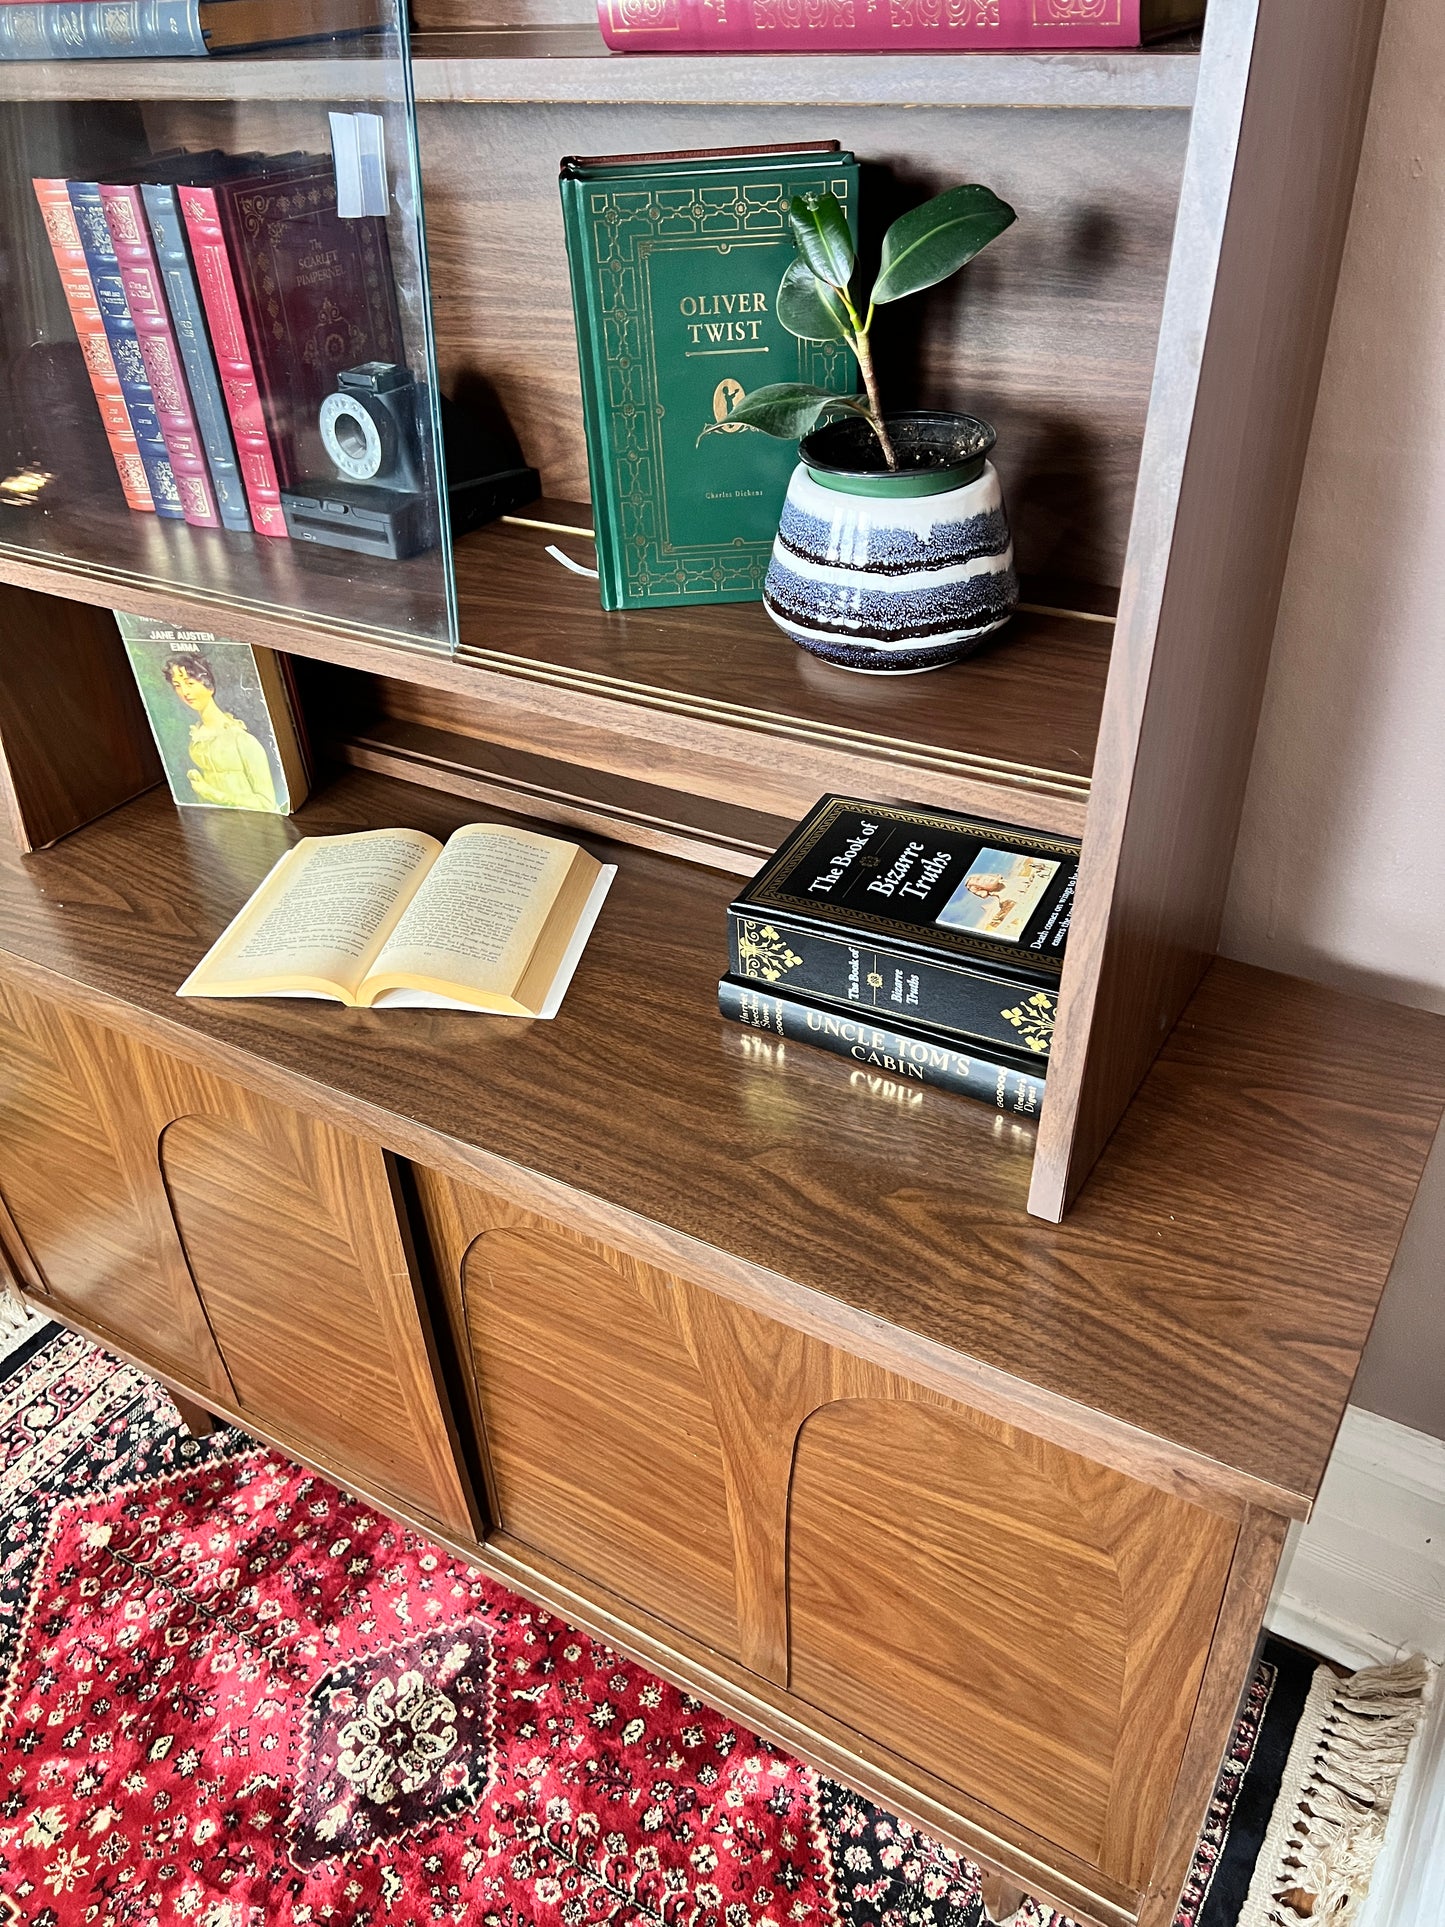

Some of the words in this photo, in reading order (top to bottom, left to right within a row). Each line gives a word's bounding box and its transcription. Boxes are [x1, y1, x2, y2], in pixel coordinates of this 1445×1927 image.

[309, 238, 322, 250] The
[298, 250, 338, 270] SCARLET
[296, 264, 346, 287] PIMPERNEL
[679, 292, 768, 317] OLIVER
[687, 319, 763, 344] TWIST
[705, 491, 732, 499] Charles
[735, 489, 763, 497] Dickens
[149, 630, 176, 640] JANE
[177, 631, 215, 641] AUSTEN
[170, 643, 200, 652] EMMA
[808, 868, 844, 893] The
[829, 837, 870, 868] Book
[860, 820, 880, 836] of
[866, 841, 925, 897] Bizarre
[898, 851, 952, 900] Truths
[1058, 887, 1075, 904] wings
[1067, 880, 1076, 888] to
[1054, 904, 1064, 912] on
[1044, 911, 1059, 931] comes
[1058, 917, 1072, 929] the
[1030, 929, 1050, 950] Death
[1051, 927, 1067, 947] enters
[848, 946, 860, 959] of
[848, 959, 860, 982] Book
[847, 982, 860, 1000] The
[890, 968, 904, 1004] Bizarre
[906, 974, 920, 1006] Truths
[739, 992, 751, 1024] Harriet
[747, 994, 761, 1028] Beecher
[760, 1003, 771, 1029] Stowe
[806, 1011, 886, 1051] UNCLE
[895, 1037, 971, 1077] TOM'S
[850, 1045, 925, 1080] CABIN
[1013, 1078, 1028, 1112] Reader's
[1023, 1085, 1038, 1113] Digest
